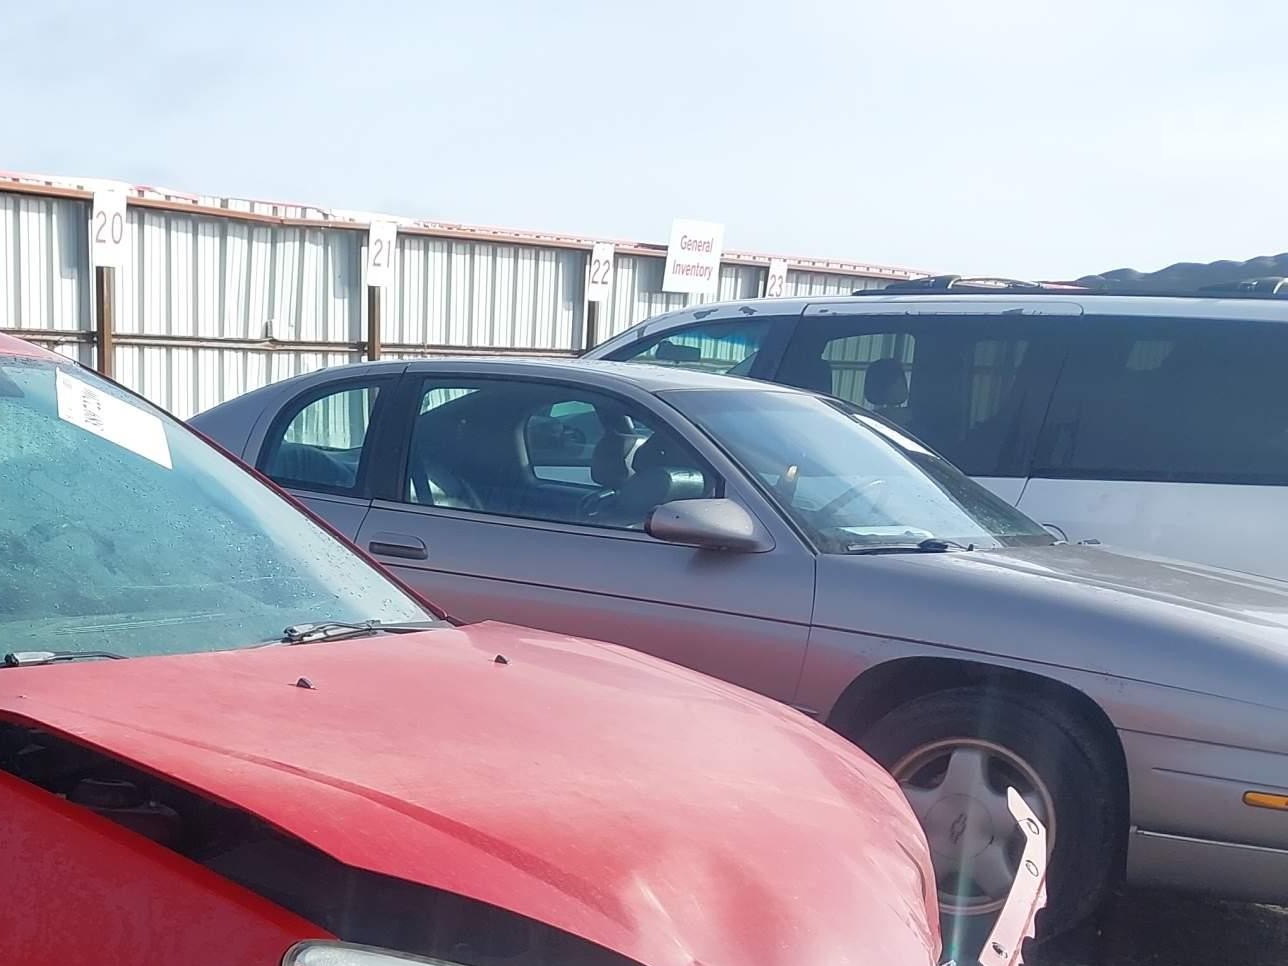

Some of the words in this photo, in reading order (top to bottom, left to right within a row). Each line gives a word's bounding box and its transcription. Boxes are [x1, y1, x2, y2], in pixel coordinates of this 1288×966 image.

[94, 210, 124, 245] 20
[372, 238, 391, 269] 21
[679, 233, 714, 254] General
[591, 258, 611, 285] 22
[672, 258, 714, 281] Inventory
[767, 273, 784, 298] 23
